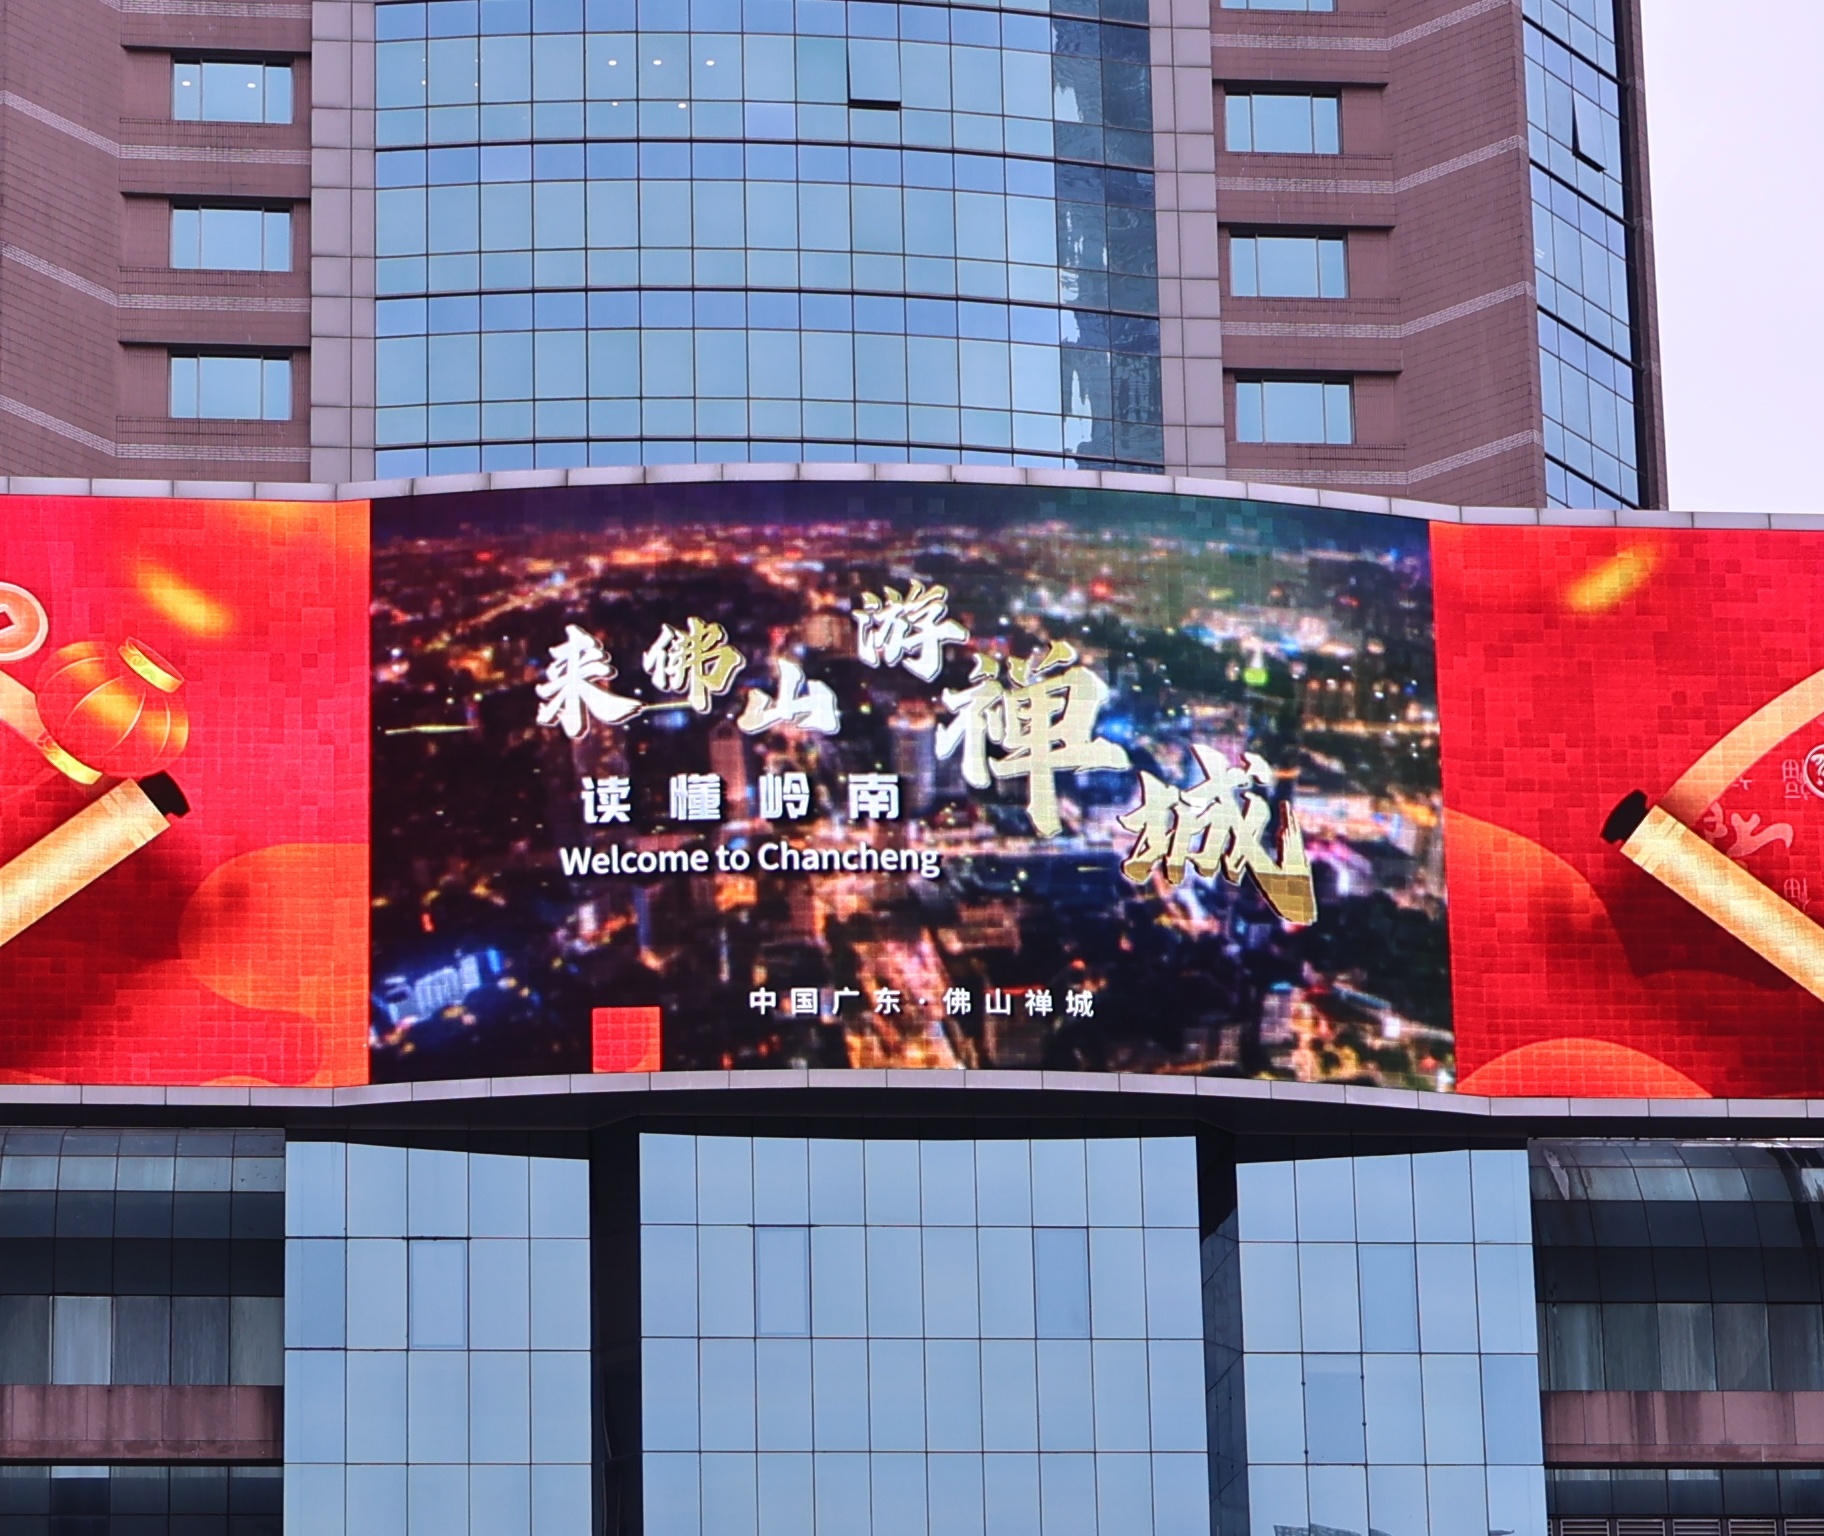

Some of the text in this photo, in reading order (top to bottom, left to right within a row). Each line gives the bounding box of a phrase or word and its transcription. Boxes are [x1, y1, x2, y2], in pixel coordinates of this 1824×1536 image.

[581, 772, 901, 824] 读懂岭南
[559, 841, 941, 878] Welcome to Chancheng
[747, 987, 1095, 1019] 中国广东·佛山禅城
